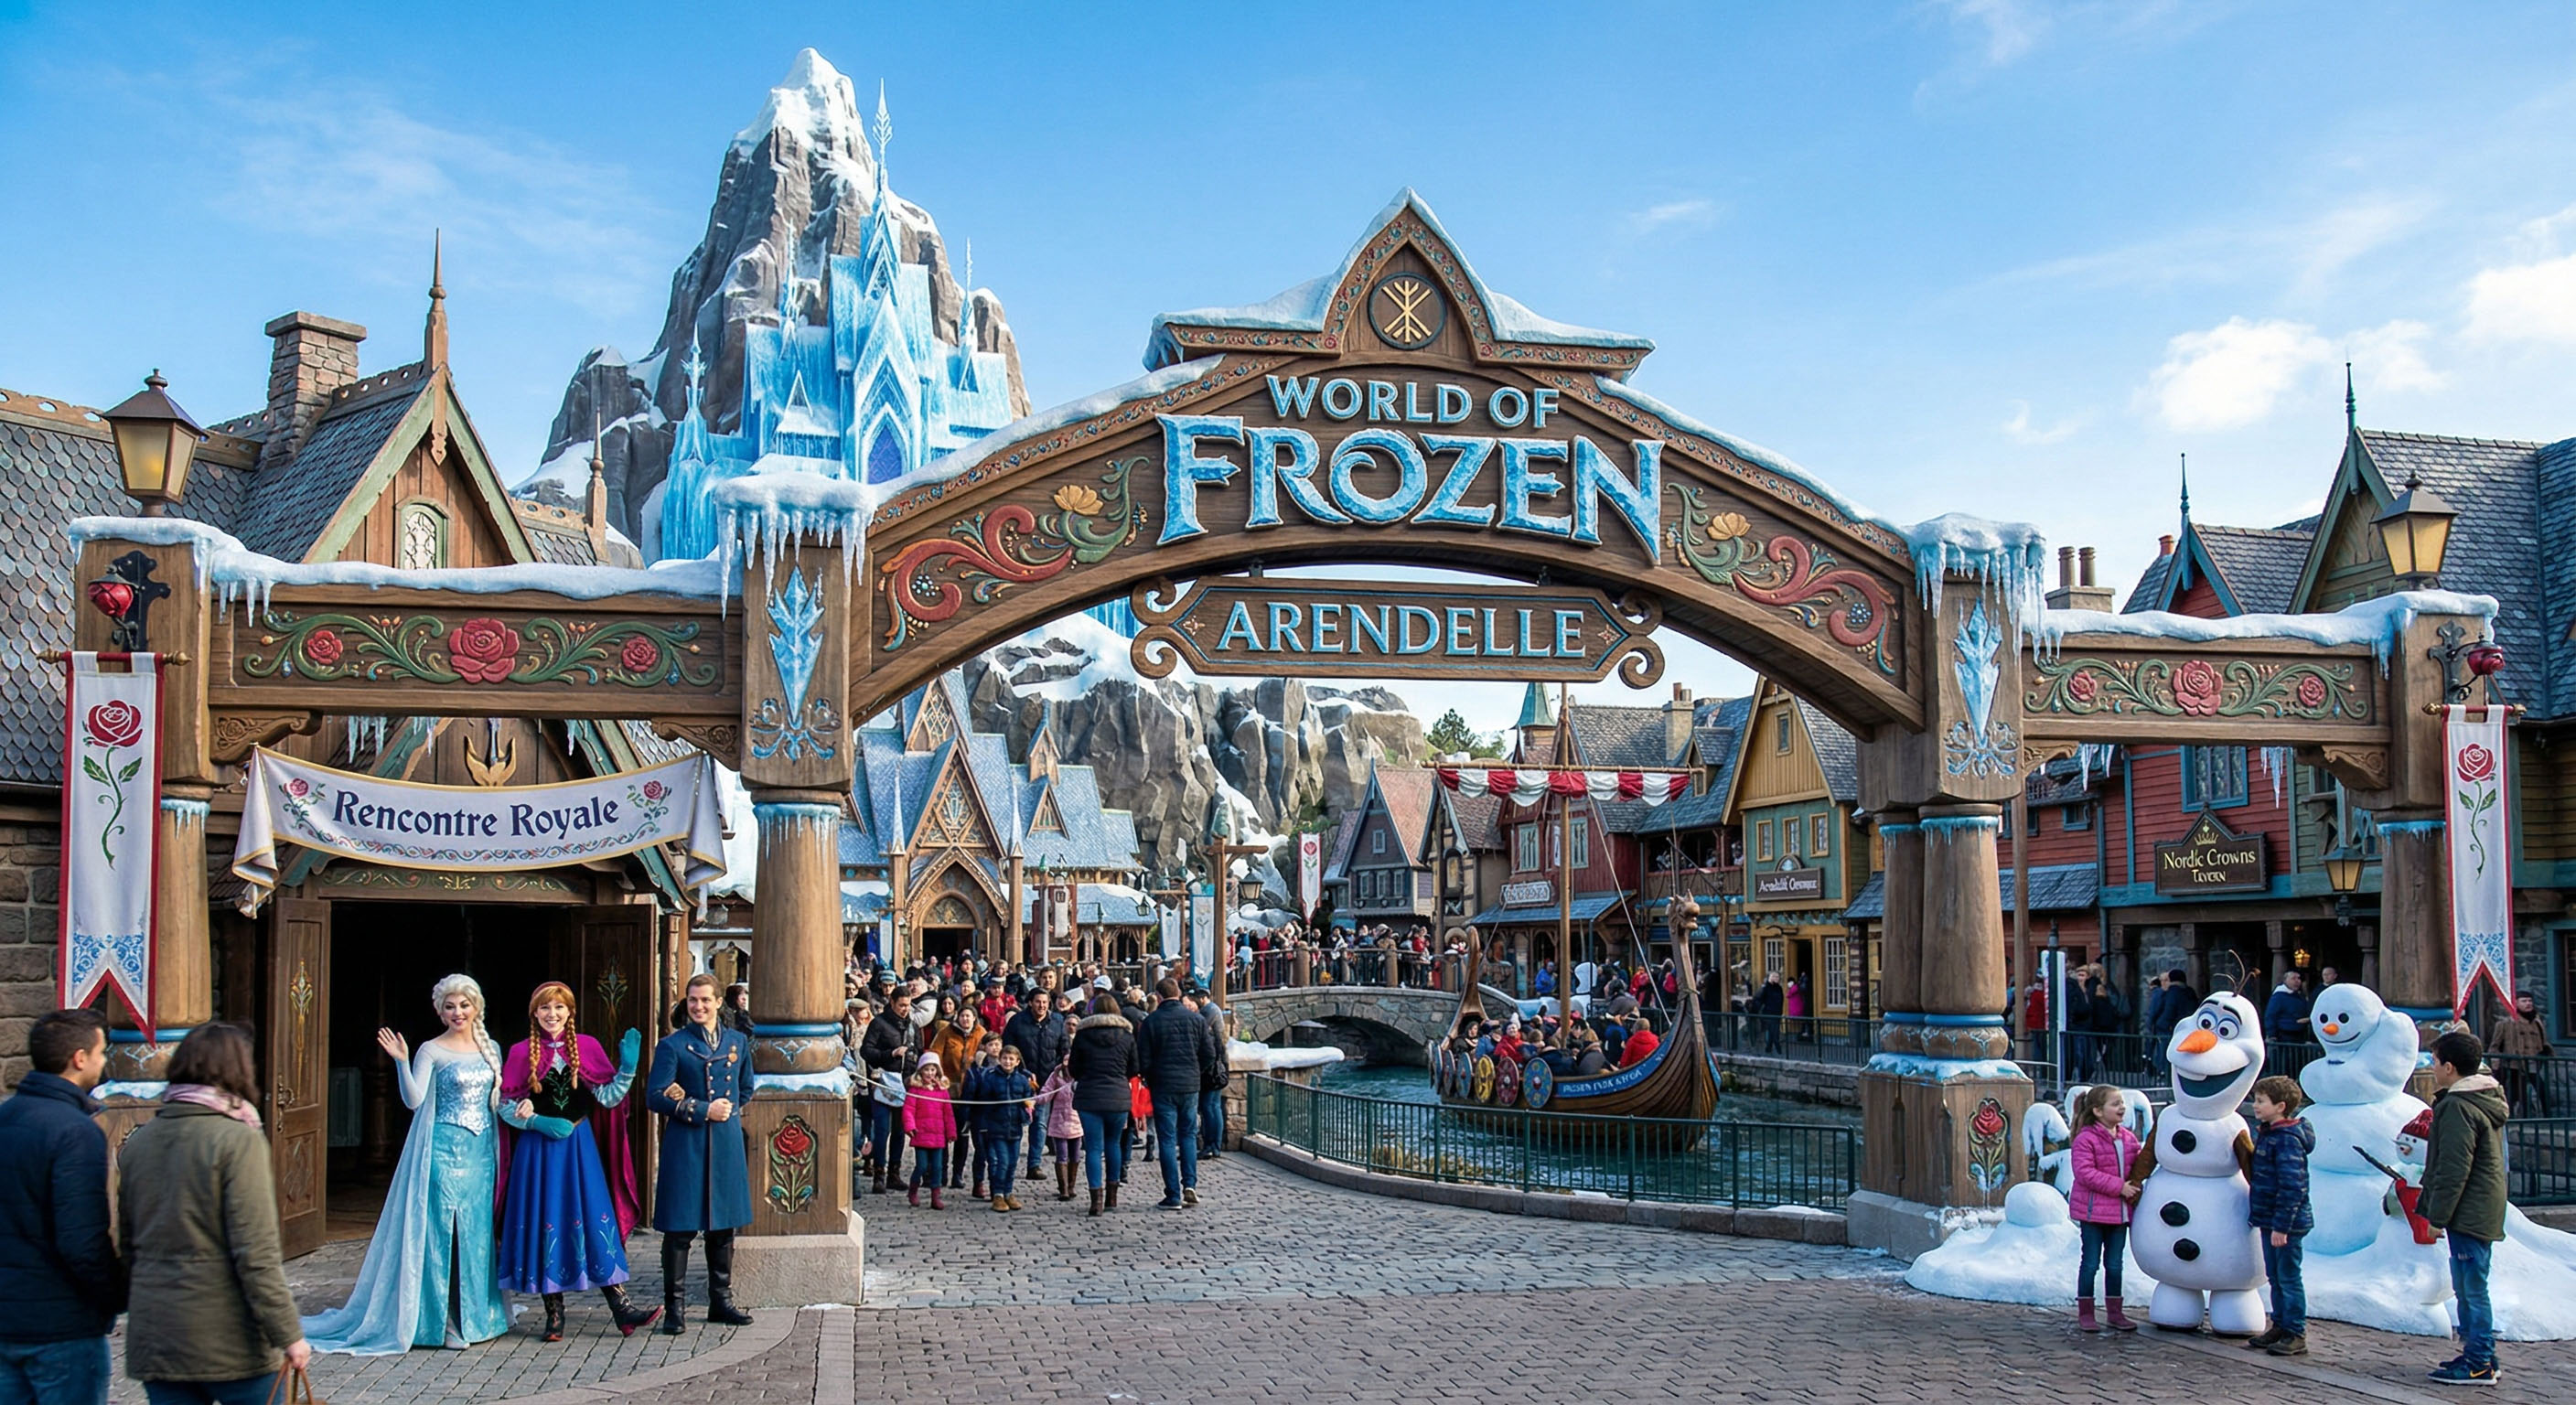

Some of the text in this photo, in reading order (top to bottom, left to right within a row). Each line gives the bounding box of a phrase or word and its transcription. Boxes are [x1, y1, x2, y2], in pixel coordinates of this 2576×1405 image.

[1265, 374, 1560, 429] WORLD OF
[1154, 413, 1667, 567] FROZEN
[1215, 600, 1587, 658] ARENDELLE
[332, 789, 619, 841] Rencontre Royale
[2163, 848, 2257, 871] Nordic Crowns
